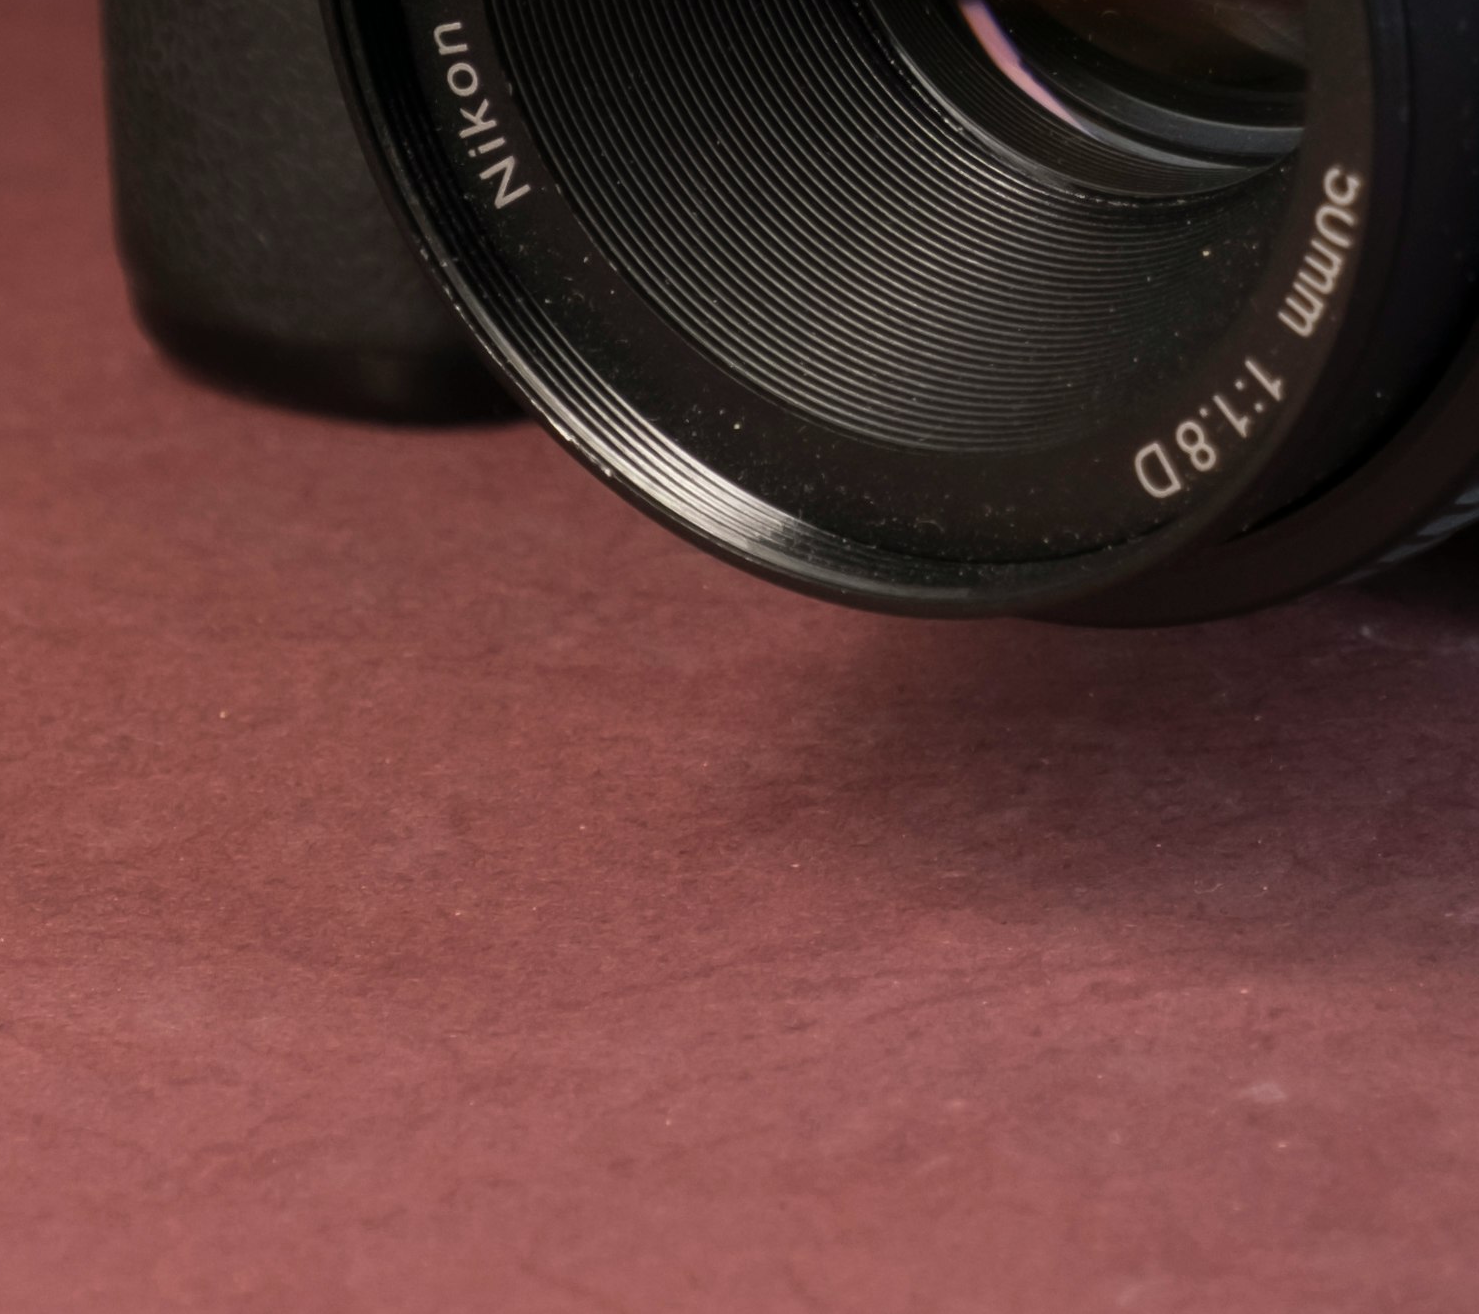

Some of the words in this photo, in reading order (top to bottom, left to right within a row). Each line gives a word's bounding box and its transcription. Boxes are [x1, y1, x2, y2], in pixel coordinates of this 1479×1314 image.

[433, 22, 532, 210] Nikon
[1276, 165, 1364, 338] 50mm
[1134, 357, 1284, 499] 1:1.8D
